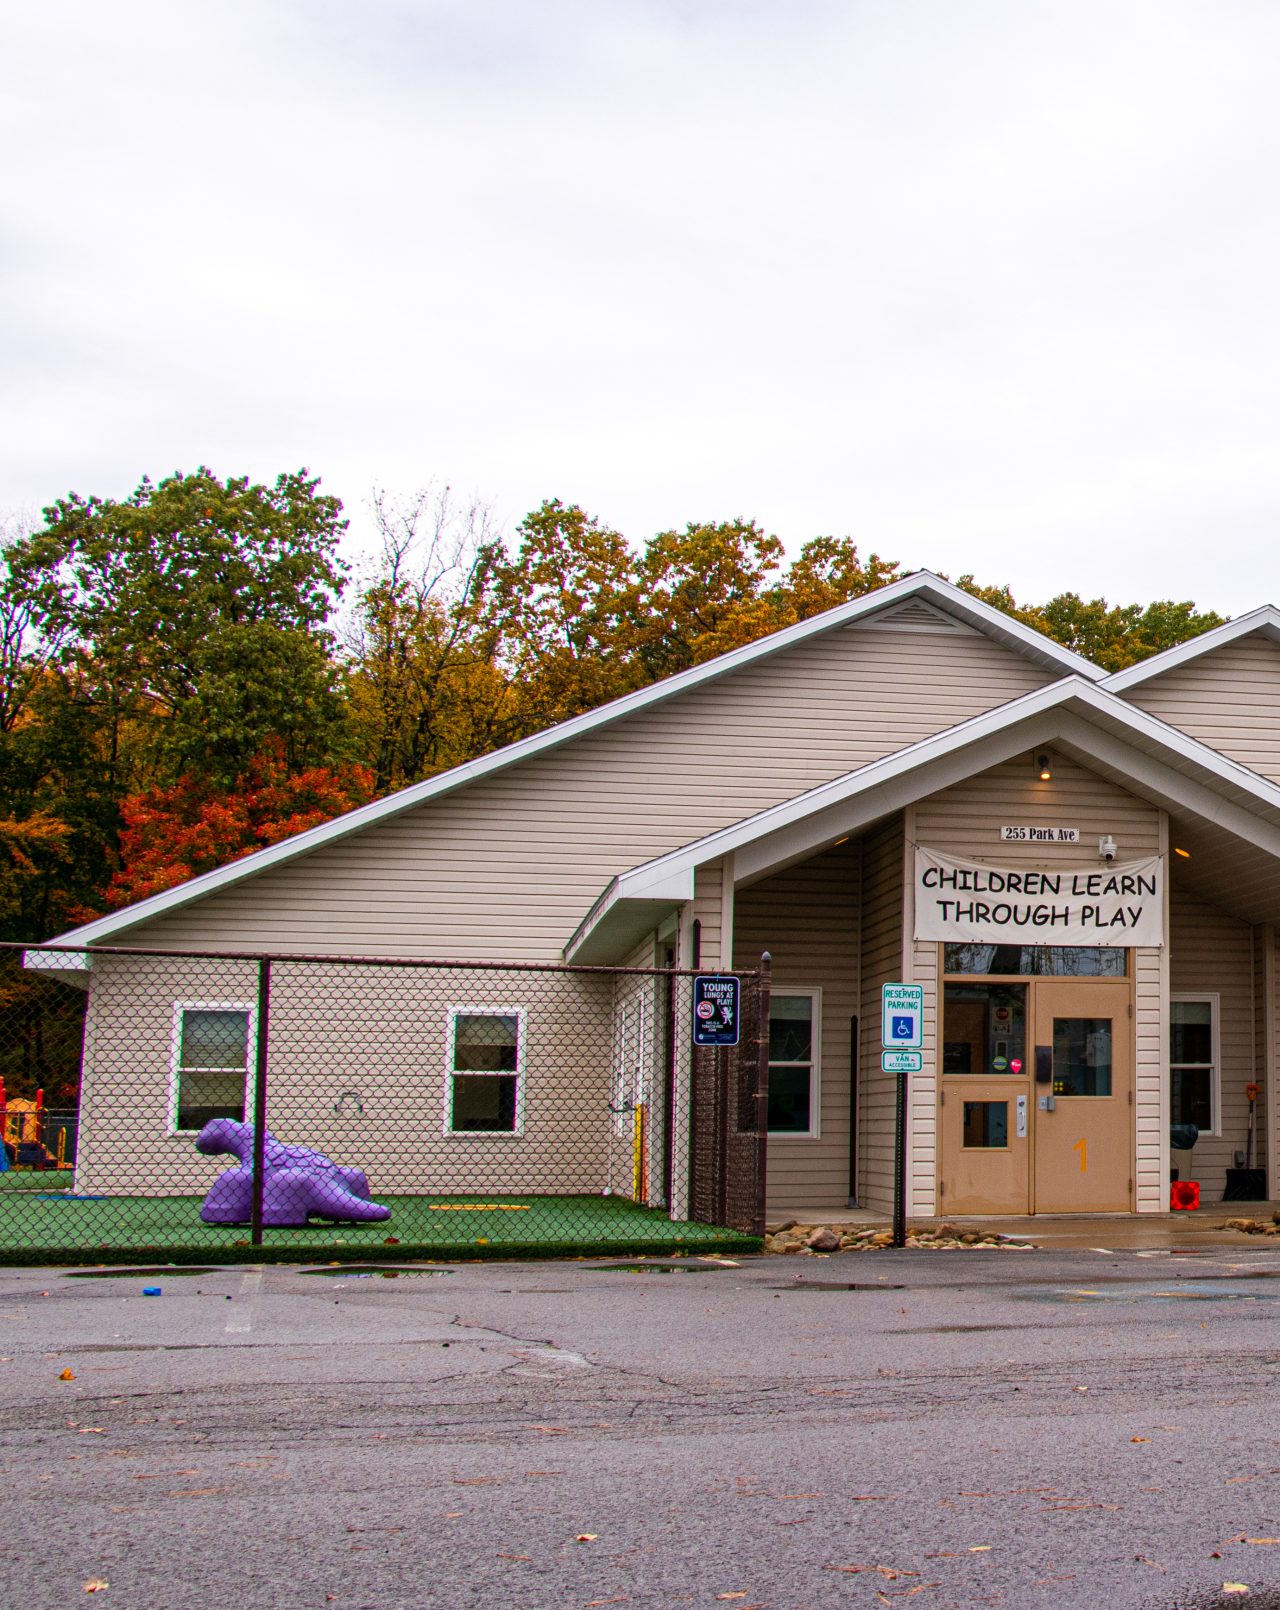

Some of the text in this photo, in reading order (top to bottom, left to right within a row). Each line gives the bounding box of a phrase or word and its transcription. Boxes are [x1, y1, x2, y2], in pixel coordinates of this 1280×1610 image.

[1005, 827, 1075, 841] 255 Park Ave
[922, 867, 1156, 896] CHILDREN LEARN
[936, 900, 1143, 927] THROUGH PLAY
[702, 983, 734, 992] YOUNG
[885, 990, 920, 999] RESERVED
[887, 1001, 918, 1010] PARKING
[1072, 1137, 1087, 1173] 1
